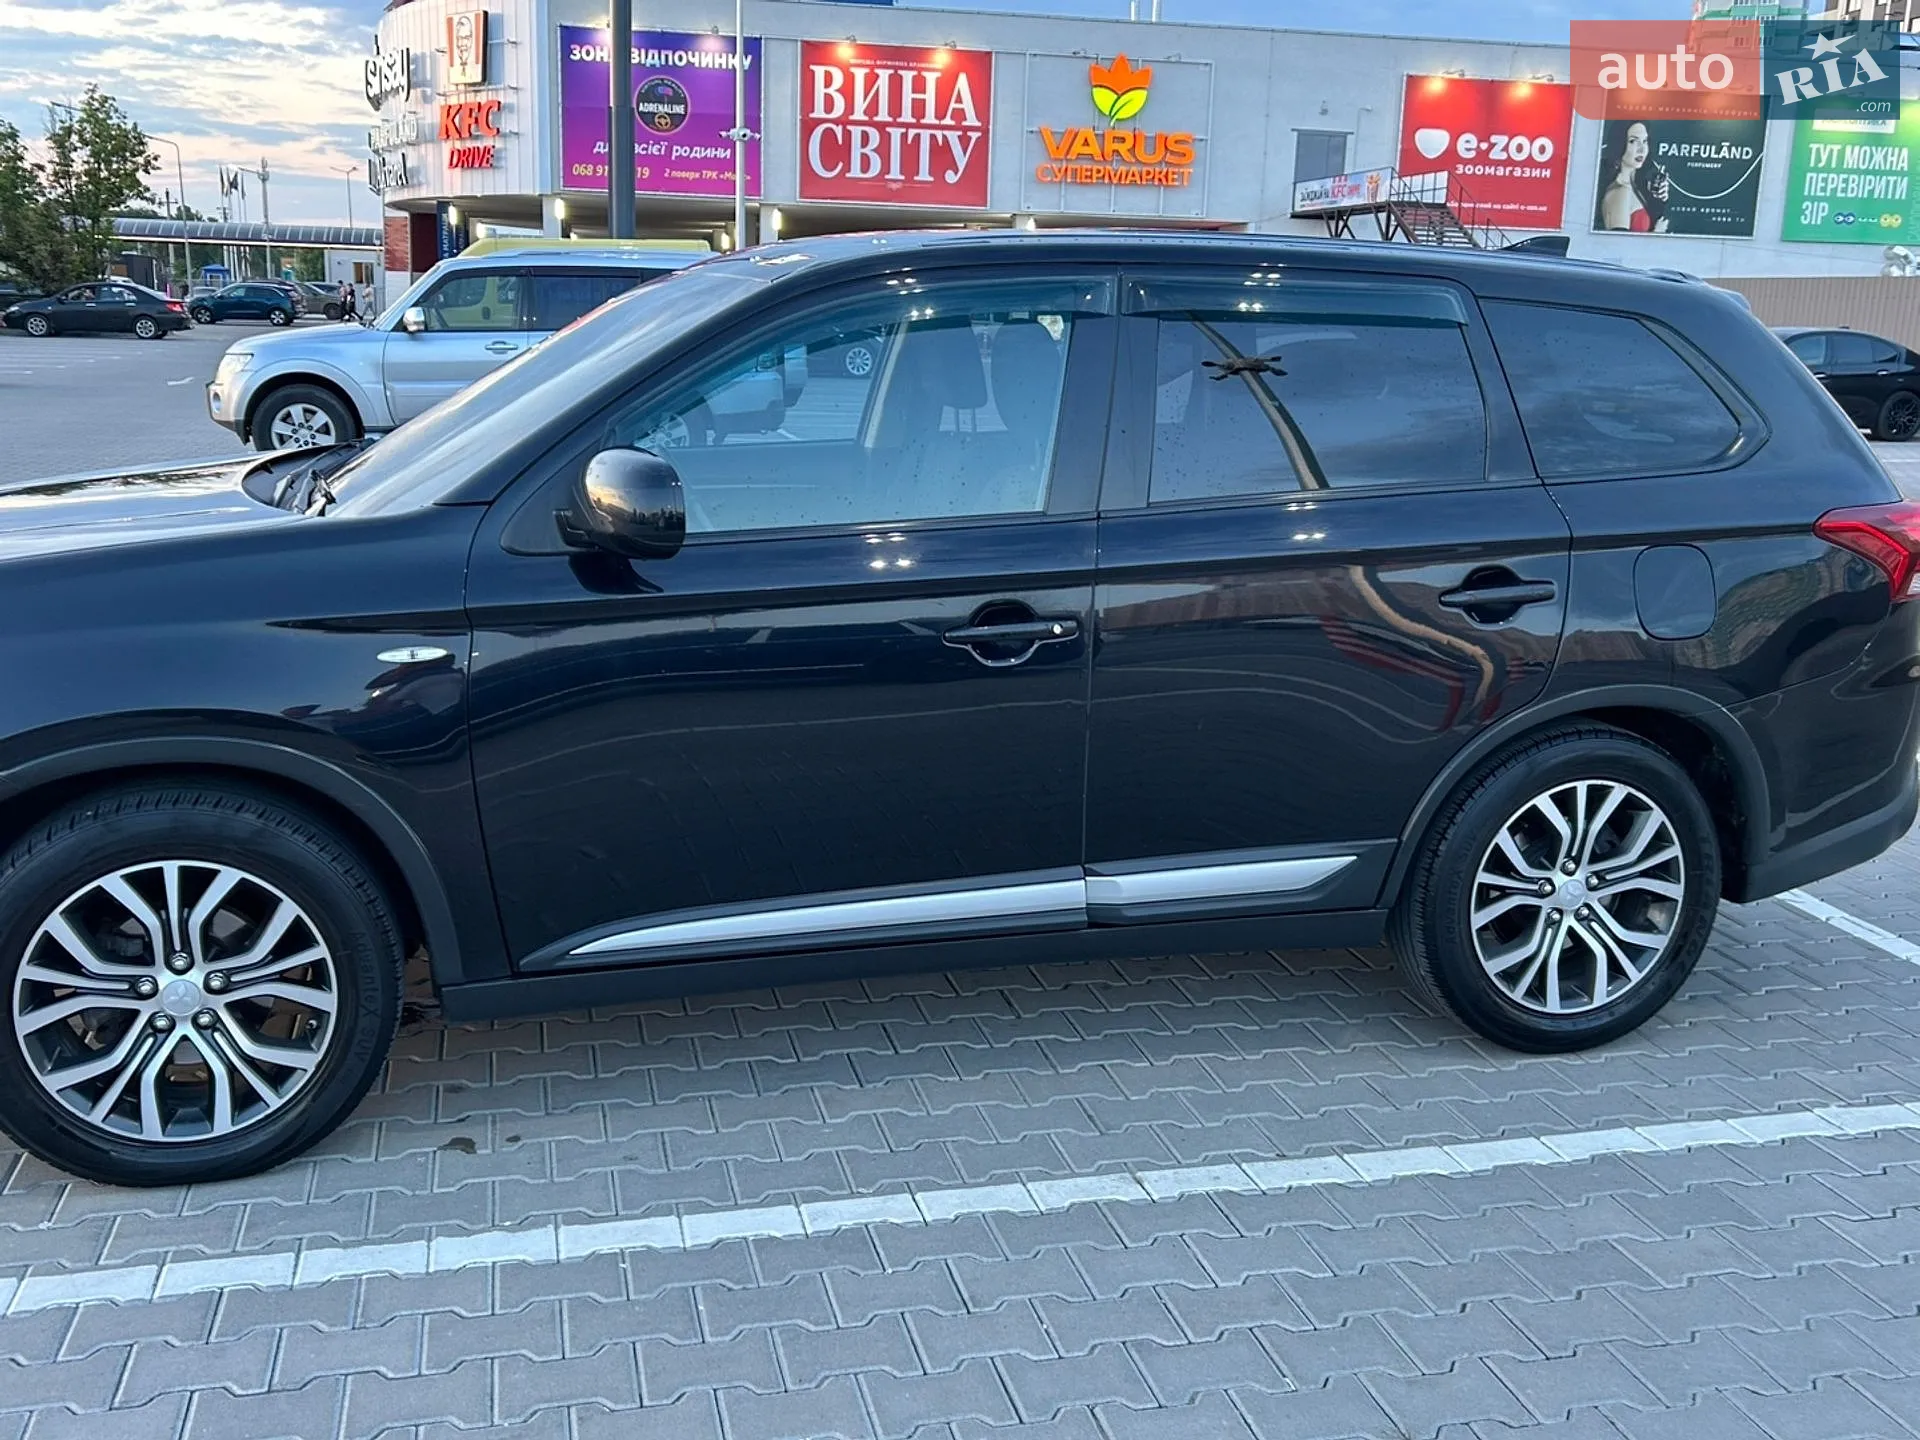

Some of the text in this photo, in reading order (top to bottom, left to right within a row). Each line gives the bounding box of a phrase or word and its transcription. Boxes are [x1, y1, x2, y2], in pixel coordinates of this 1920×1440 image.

[569, 44, 613, 62] ЗОН
[809, 65, 982, 126] ВИНА
[439, 99, 502, 141] KFC
[639, 102, 685, 114] ADRENALINE
[448, 145, 496, 169] DRIVE
[672, 145, 731, 161] родини
[808, 122, 982, 184] СВІТУ
[1039, 126, 1197, 165] VARUS
[1809, 143, 1908, 171] ТУТ МОЖНА
[572, 163, 592, 176] 068
[1036, 163, 1193, 187] СУПЕРМАРКЕТ
[1456, 163, 1551, 178] зоомагазин
[1804, 172, 1908, 200] ПЕРЕВІРИТИ
[1800, 201, 1829, 225] ЗІР
